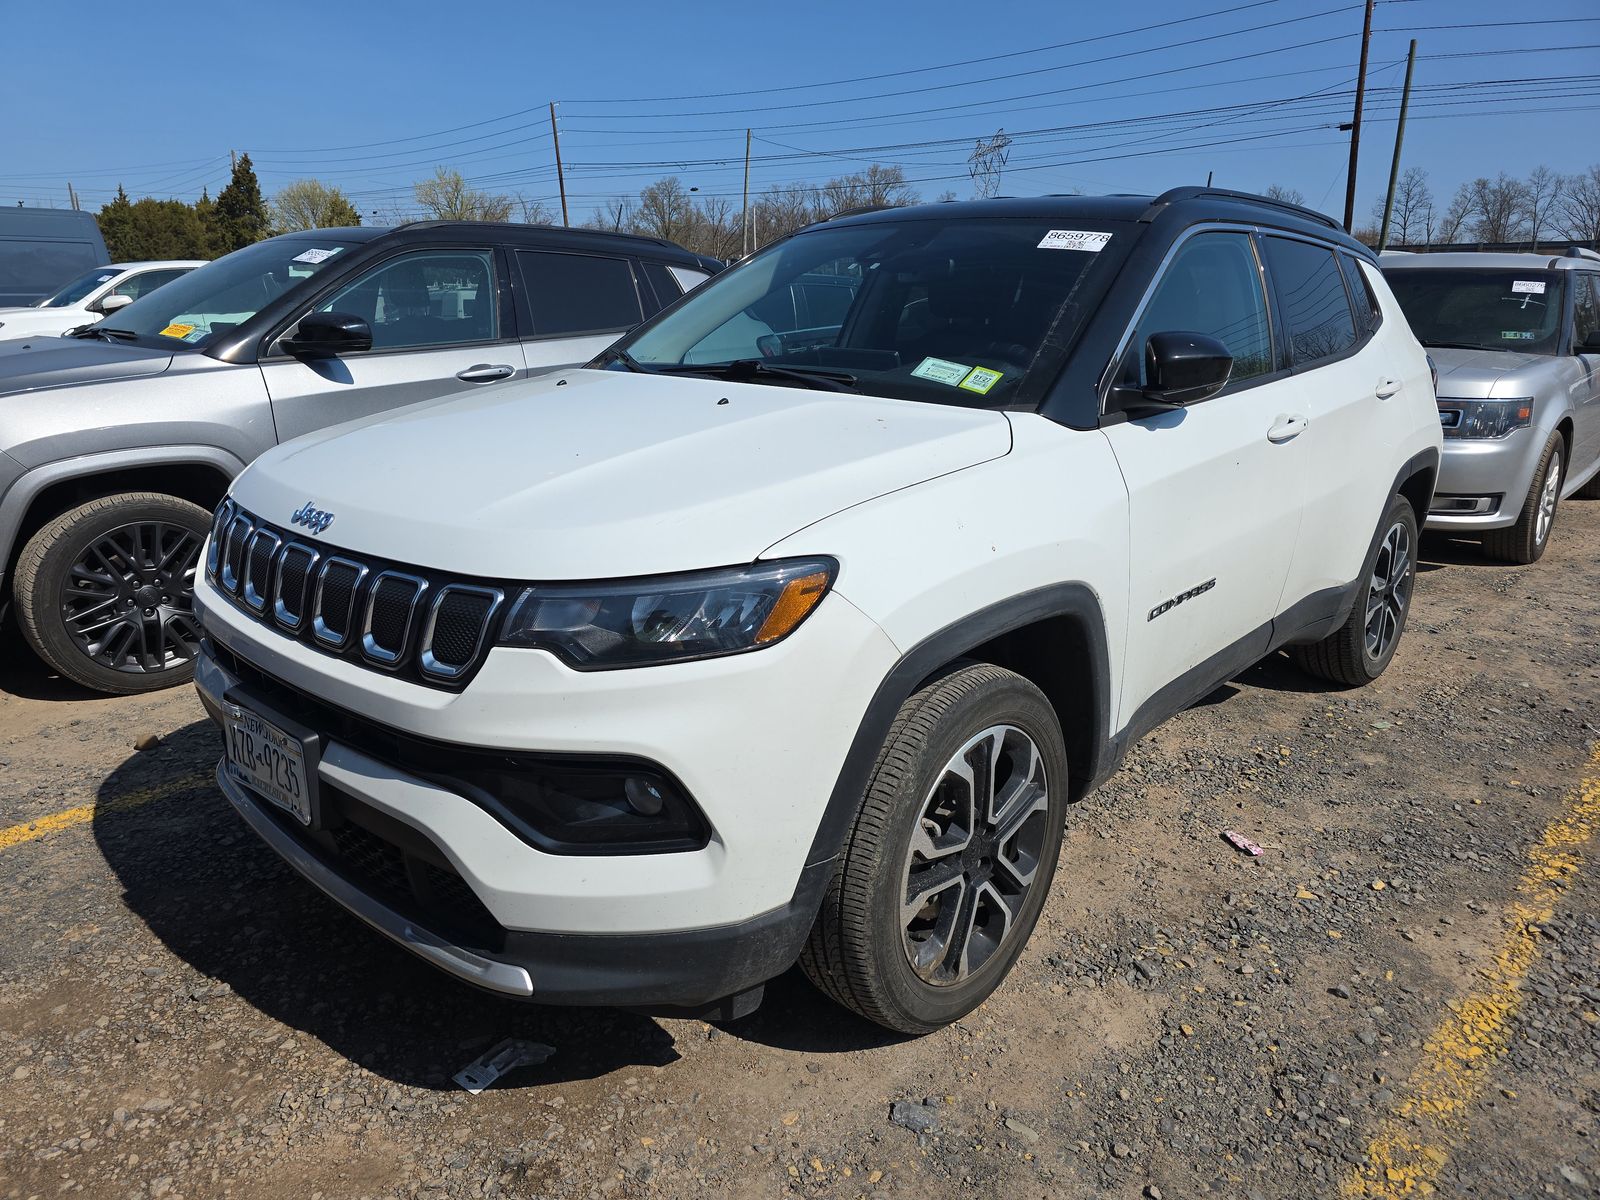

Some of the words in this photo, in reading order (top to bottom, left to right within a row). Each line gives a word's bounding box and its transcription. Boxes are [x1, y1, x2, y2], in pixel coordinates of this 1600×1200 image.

[1048, 232, 1110, 242] 8659778
[291, 501, 335, 535] Jeep
[1147, 577, 1217, 622] COMPASS
[244, 715, 263, 737] NEW
